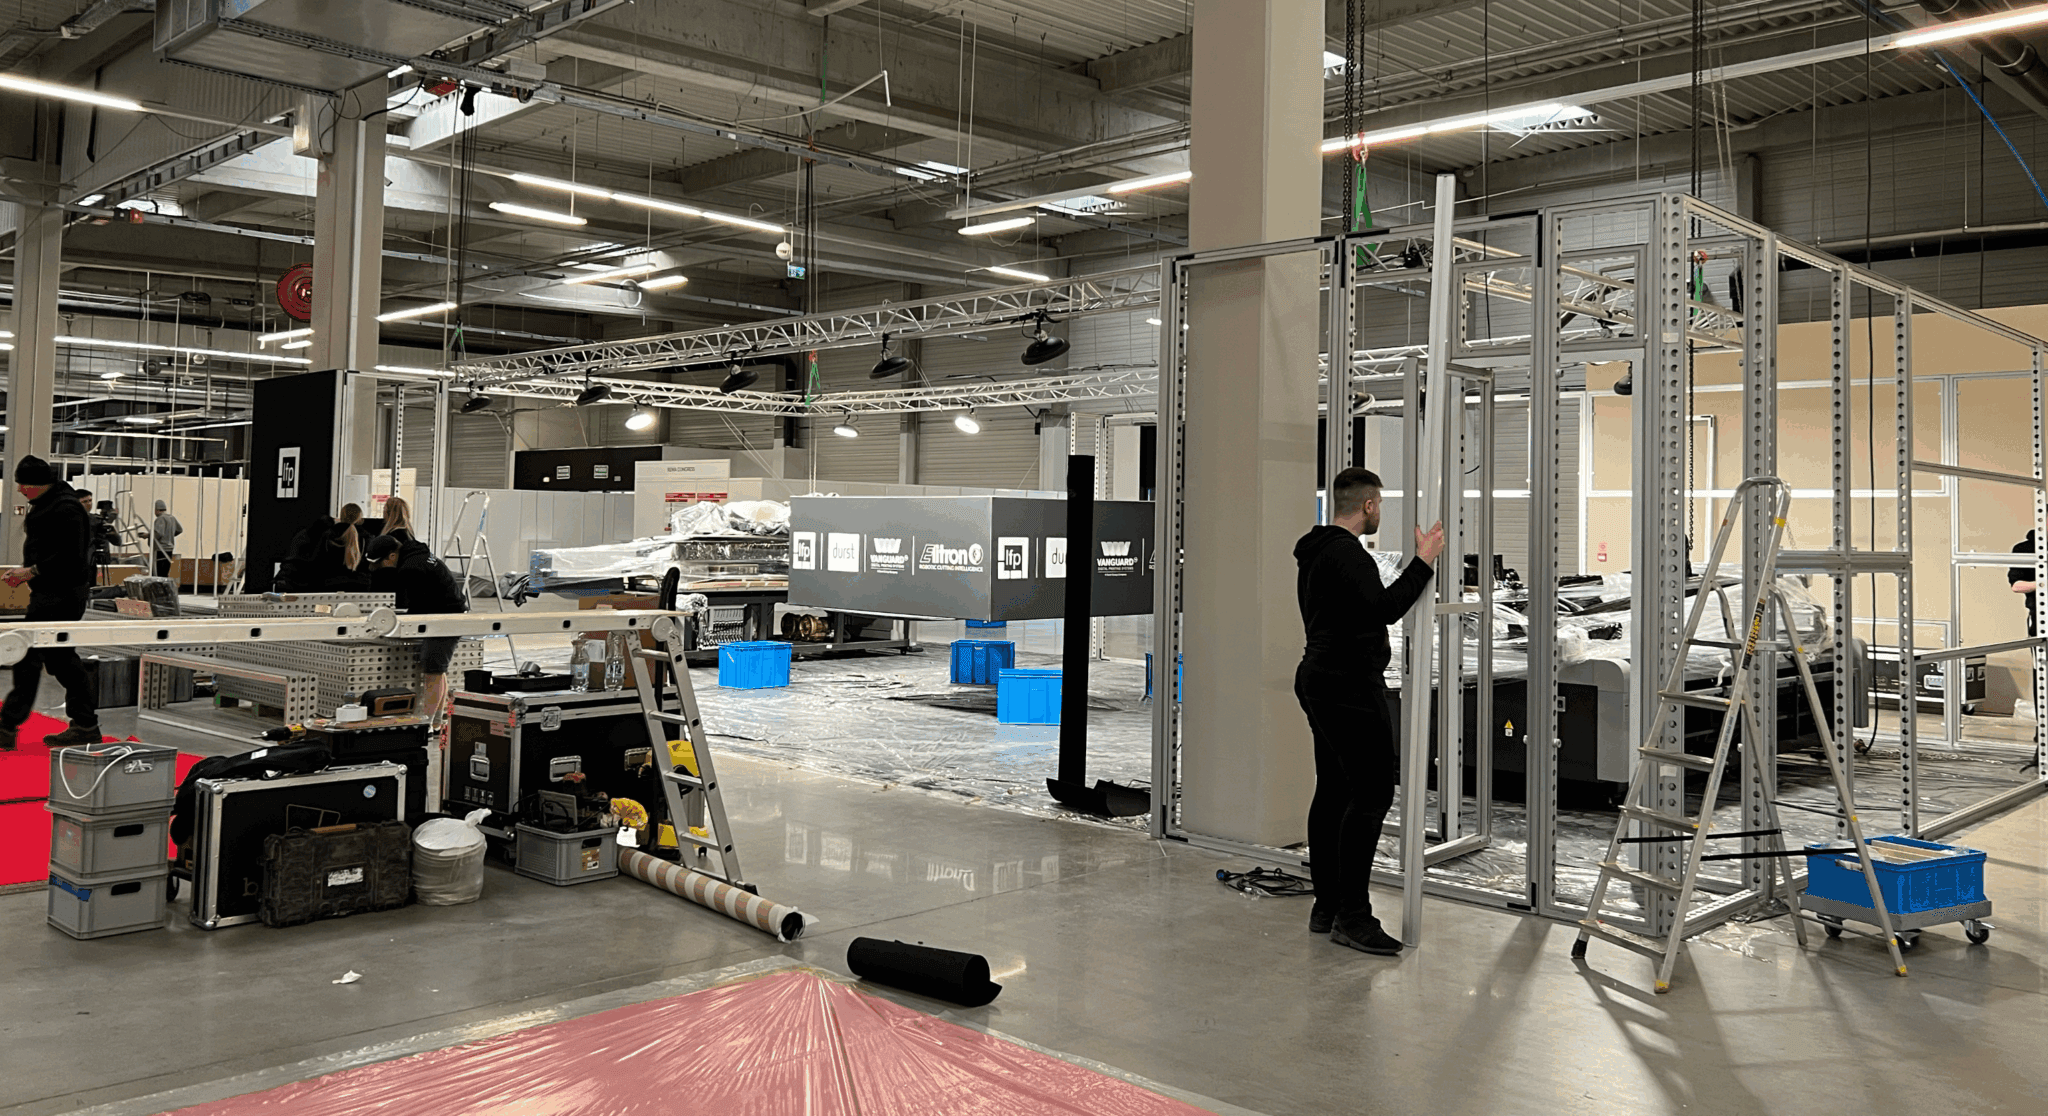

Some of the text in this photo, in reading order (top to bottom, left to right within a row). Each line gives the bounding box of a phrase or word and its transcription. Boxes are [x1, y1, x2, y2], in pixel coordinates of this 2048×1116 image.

[283, 462, 294, 486] lfp
[799, 542, 811, 560] lfp
[832, 545, 855, 560] durst
[919, 543, 968, 565] Elitron
[1005, 548, 1022, 569] lfp
